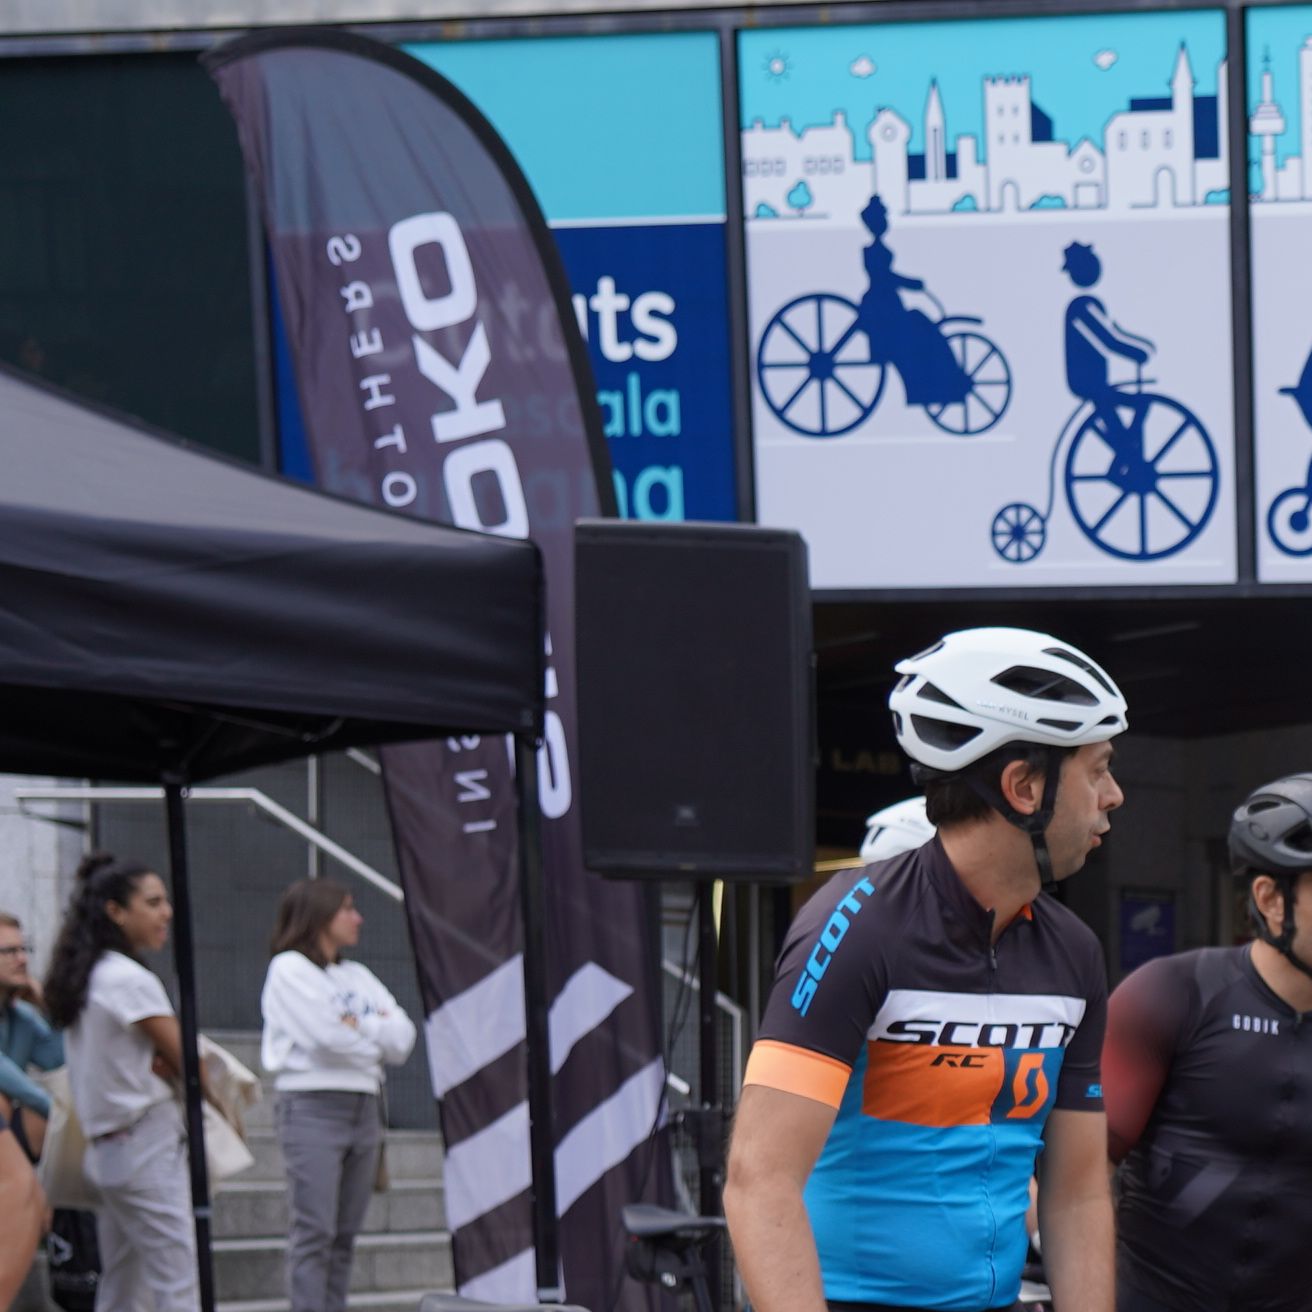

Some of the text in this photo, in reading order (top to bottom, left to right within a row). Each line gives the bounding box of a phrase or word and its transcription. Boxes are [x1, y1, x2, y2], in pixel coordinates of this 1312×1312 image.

[791, 876, 876, 1018] SCOTT
[885, 1020, 1078, 1049] SCOTT
[930, 1052, 989, 1069] RC
